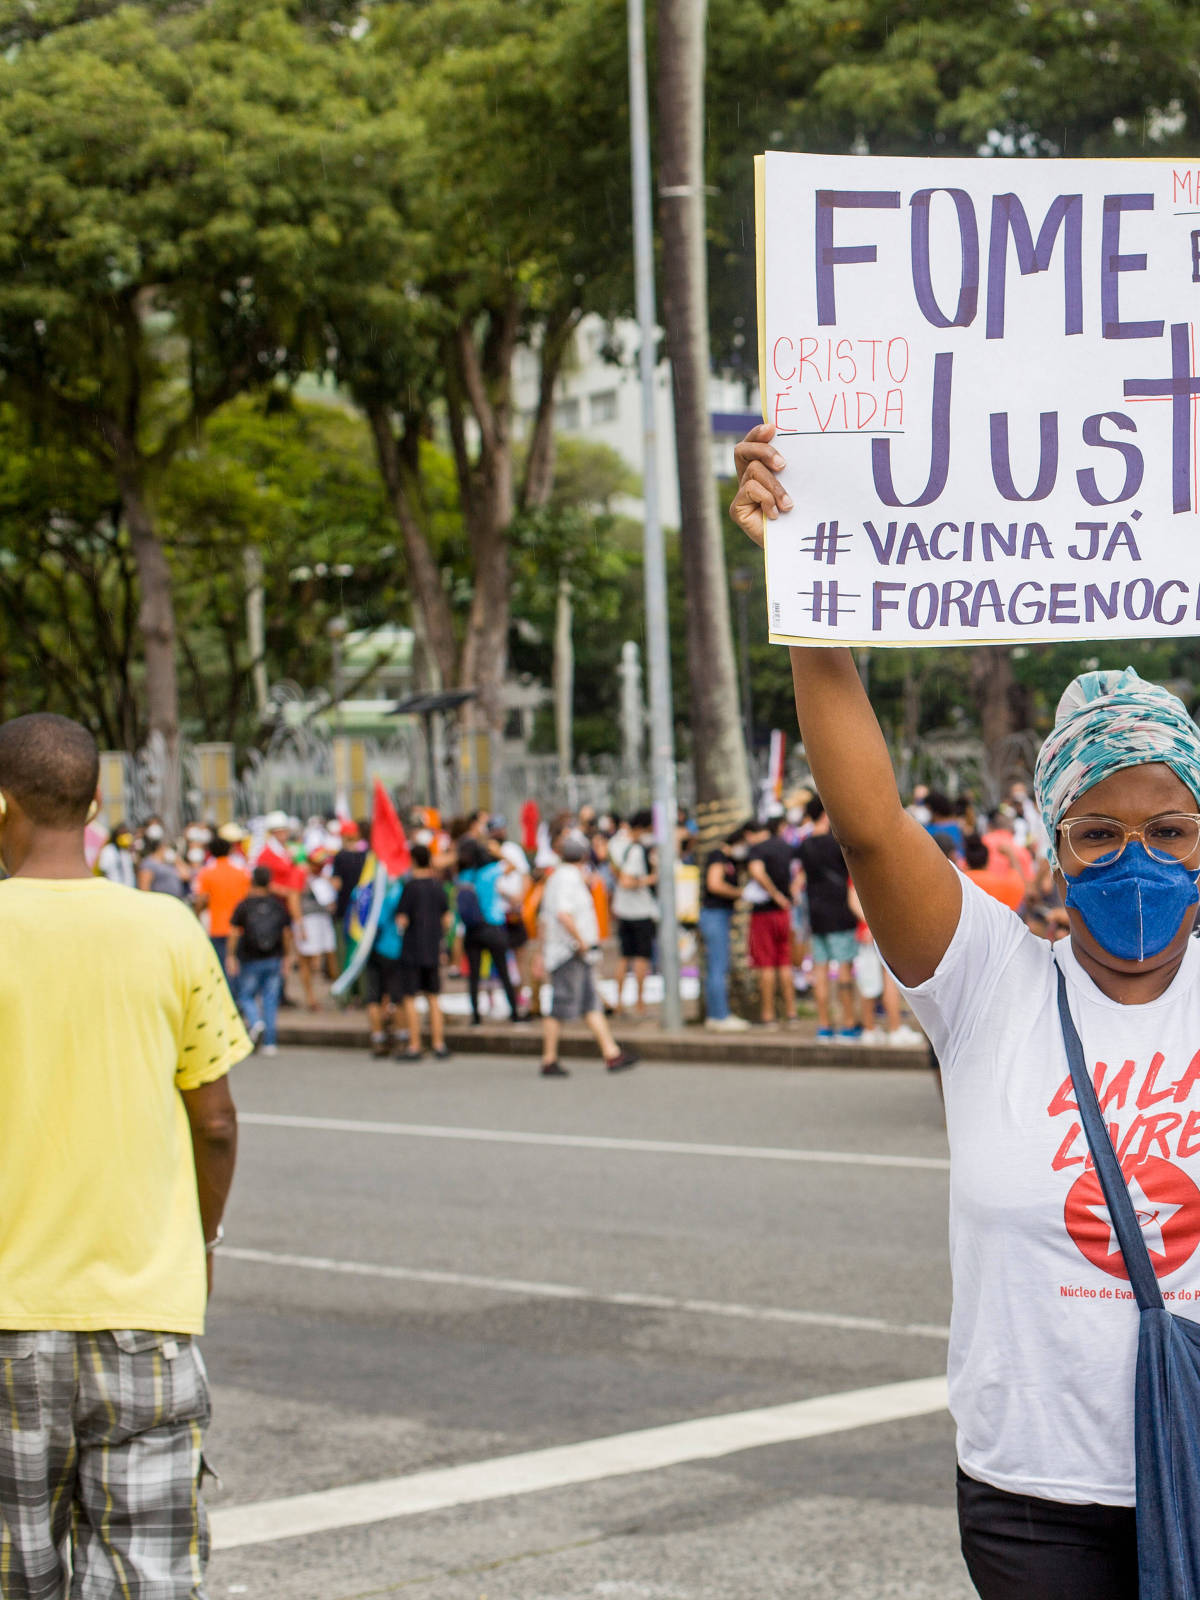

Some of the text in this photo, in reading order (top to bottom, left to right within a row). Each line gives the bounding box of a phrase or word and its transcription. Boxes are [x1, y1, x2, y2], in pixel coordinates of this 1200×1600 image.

[815, 187, 1165, 339] FOME
[773, 336, 909, 384] CRISTO
[808, 388, 904, 432] VIDA
[1067, 509, 1143, 563] JÁ
[1060, 1285, 1097, 1299] Núcleo
[1099, 1287, 1113, 1299] de
[1178, 1289, 1192, 1301] do
